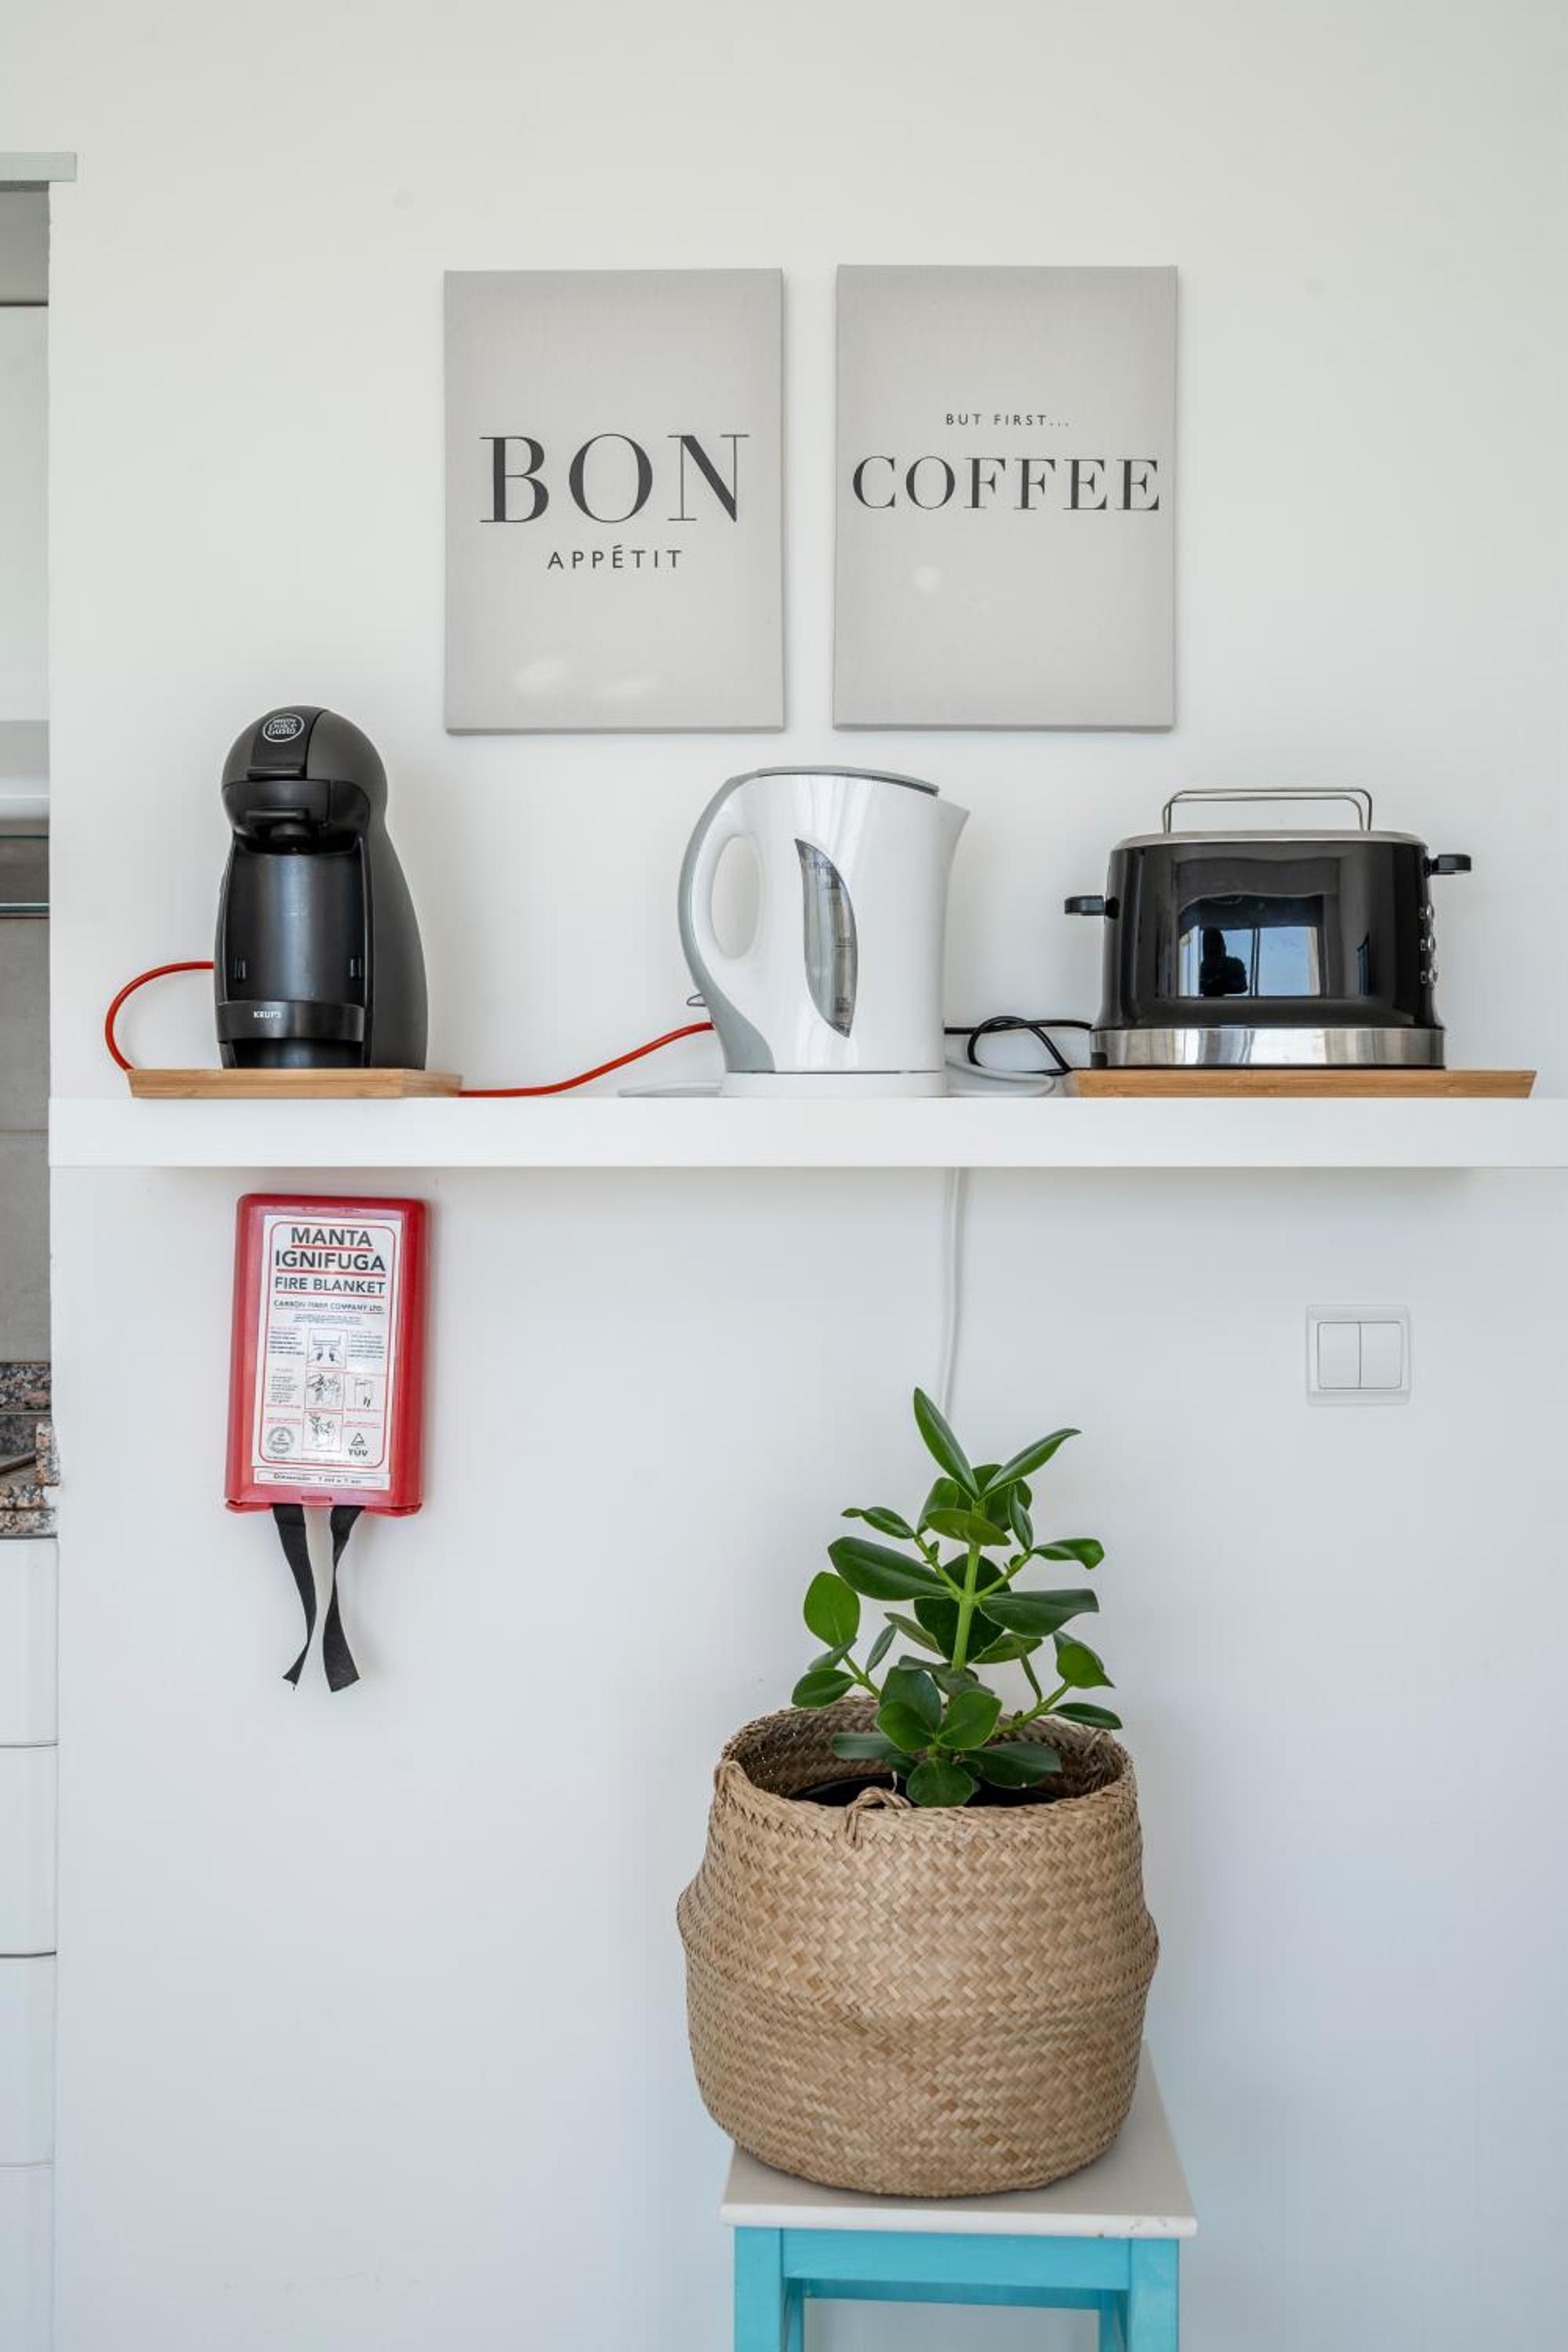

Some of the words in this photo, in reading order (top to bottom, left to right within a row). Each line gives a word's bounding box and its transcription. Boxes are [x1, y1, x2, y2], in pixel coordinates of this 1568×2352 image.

[946, 413, 982, 426] BUT
[993, 414, 1070, 428] FIRST...
[479, 434, 750, 523] BON
[852, 455, 1160, 510] COFFEE
[547, 545, 682, 570] APPÉTIT
[291, 1227, 372, 1247] MANTA
[275, 1250, 387, 1272] IGNIFUGA
[275, 1276, 307, 1290] FIRE
[314, 1279, 386, 1294] BLANKET
[329, 1302, 368, 1311] COMPANY
